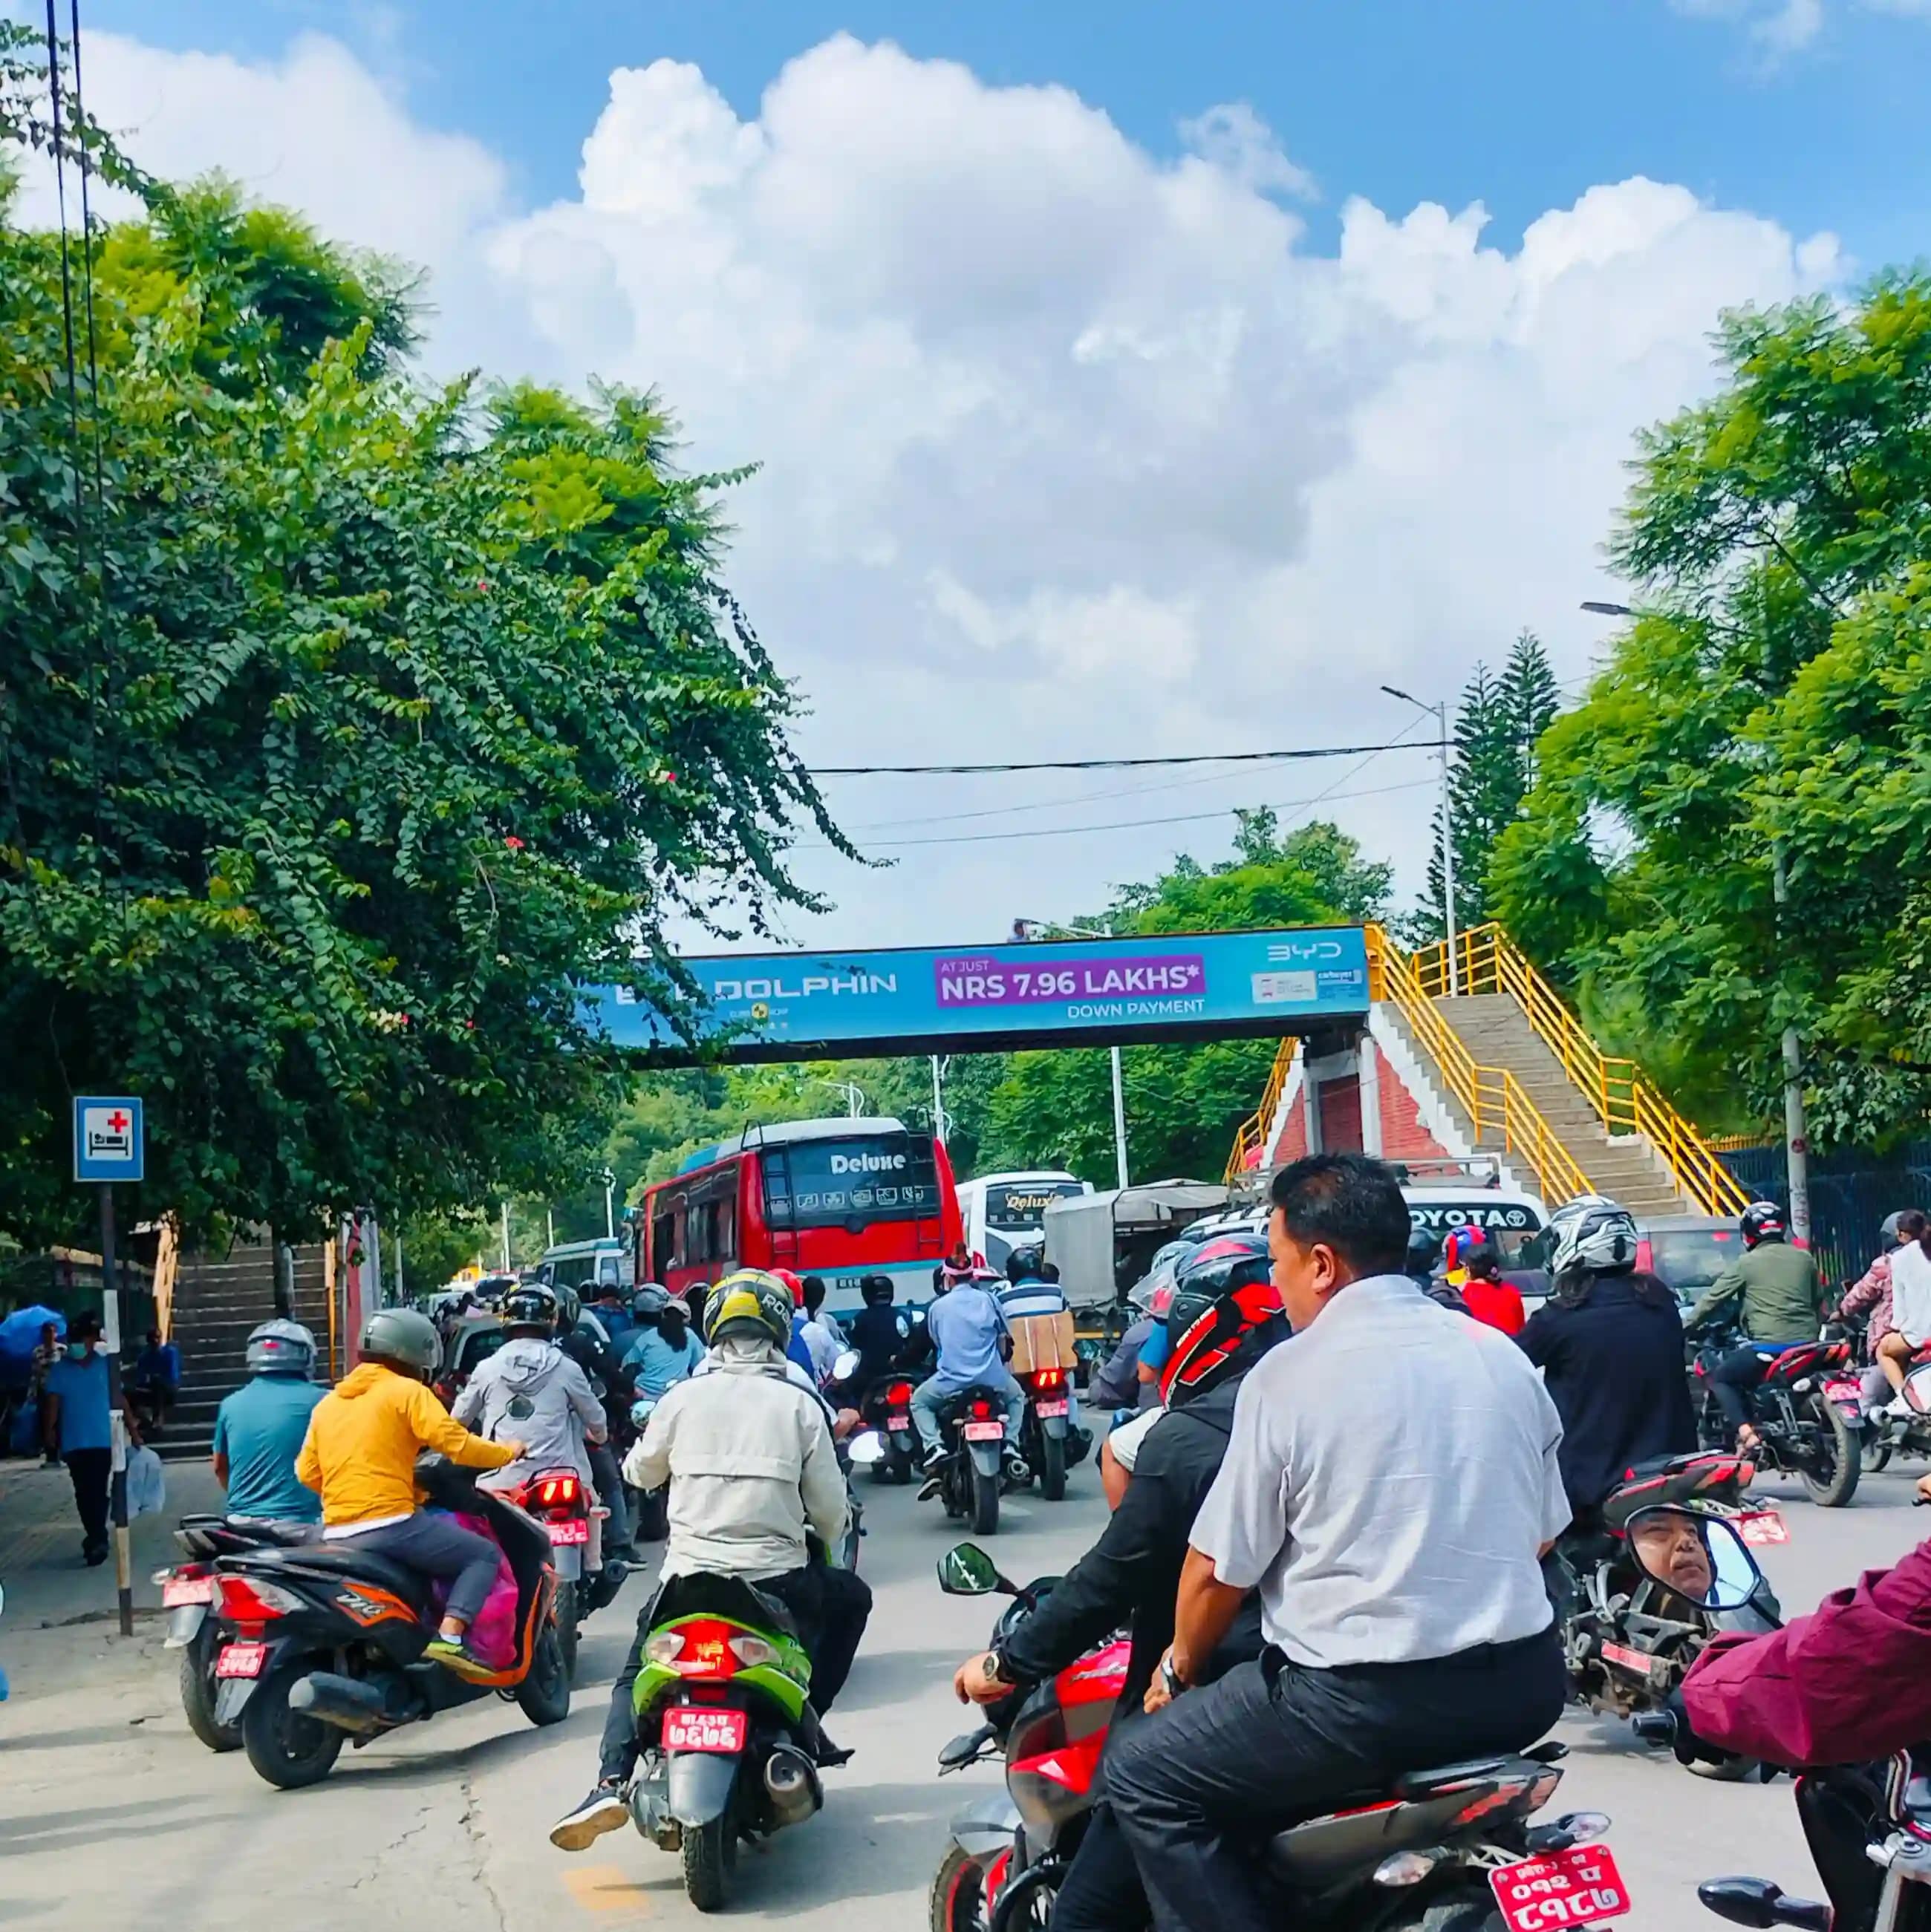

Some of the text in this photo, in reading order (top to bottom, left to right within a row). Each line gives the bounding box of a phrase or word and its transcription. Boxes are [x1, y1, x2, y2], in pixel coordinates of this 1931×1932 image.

[1267, 942, 1342, 961] BYD
[942, 961, 989, 973] AT JUST
[714, 973, 897, 1000] DOLPHIN
[942, 975, 1006, 1000] NRS
[1013, 972, 1075, 997] 7.96
[1067, 999, 1205, 1018] DOWN PAYMENT
[831, 1152, 906, 1175] Deluxe
[1005, 1192, 1052, 1211] Delux
[1408, 1210, 1508, 1227] OYOTA
[1512, 1888, 1620, 1931] ८१८७
